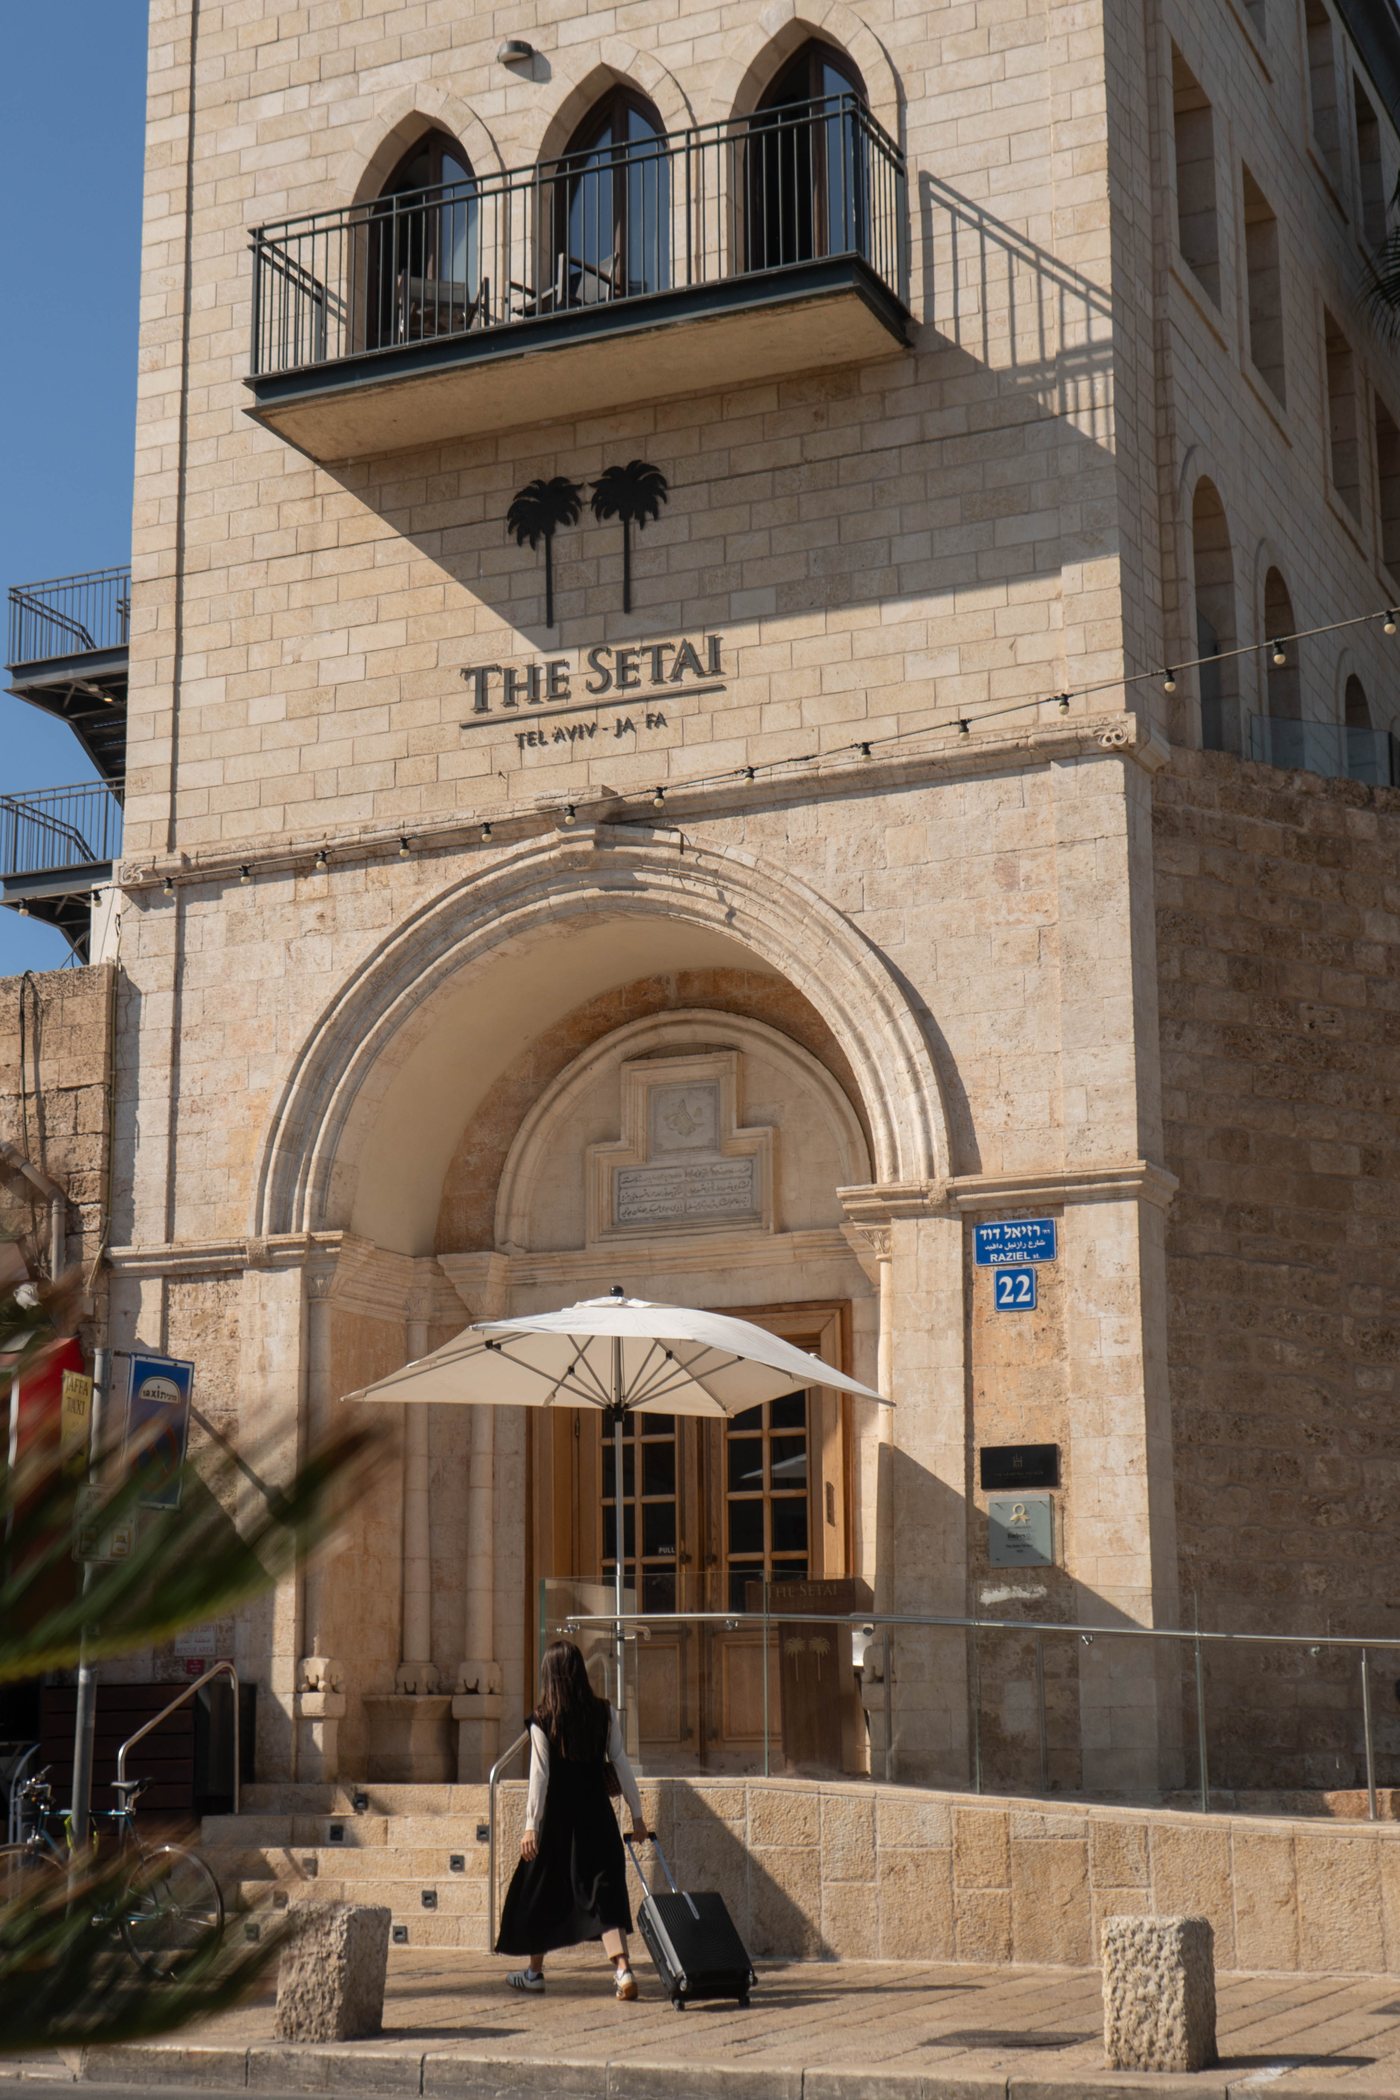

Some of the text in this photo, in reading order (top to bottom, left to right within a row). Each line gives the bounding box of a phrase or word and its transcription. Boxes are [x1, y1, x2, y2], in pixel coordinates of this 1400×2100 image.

[460, 634, 723, 714] THE SETAI
[515, 730, 549, 750] TEL
[553, 722, 598, 744] AVIV
[980, 1229, 1001, 1241] דוד
[1004, 1225, 1040, 1239] רזיאל
[1028, 1239, 1046, 1249] شارع
[990, 1251, 1031, 1262] RAZIEL
[998, 1274, 1031, 1304] 22
[66, 1396, 86, 1416] TAXI
[658, 1546, 675, 1554] PULL
